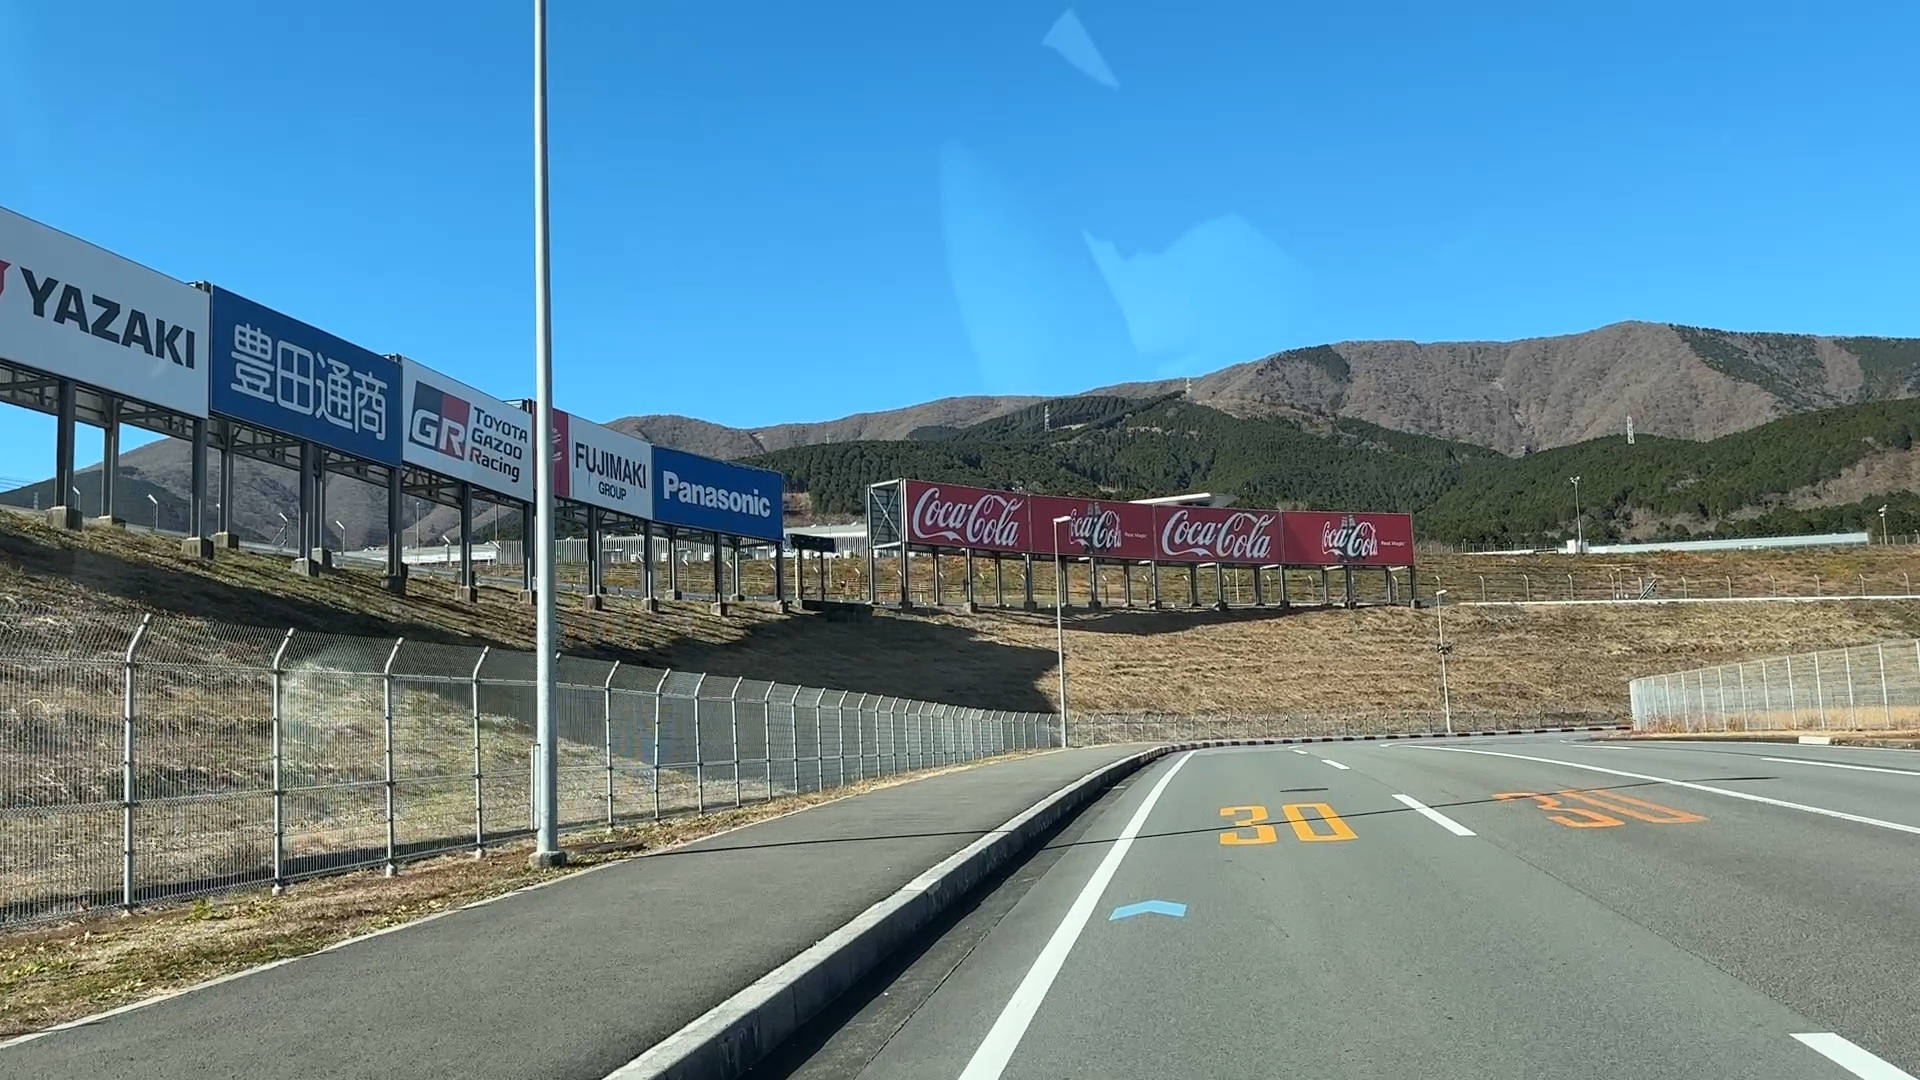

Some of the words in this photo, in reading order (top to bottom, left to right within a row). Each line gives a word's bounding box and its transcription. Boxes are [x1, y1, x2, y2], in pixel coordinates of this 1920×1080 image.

[20, 266, 195, 369] YAZAKI
[231, 323, 388, 441] 豊田通商
[412, 408, 466, 457] GR
[471, 427, 523, 460] GAZOO
[473, 406, 528, 443] TOYOTA
[469, 447, 520, 483] Racing
[575, 441, 647, 489] FUJIMAKI
[598, 481, 627, 501] GROUP
[663, 470, 771, 518] Panasonic
[1219, 802, 1359, 845] 30
[1490, 789, 1710, 828] 30
